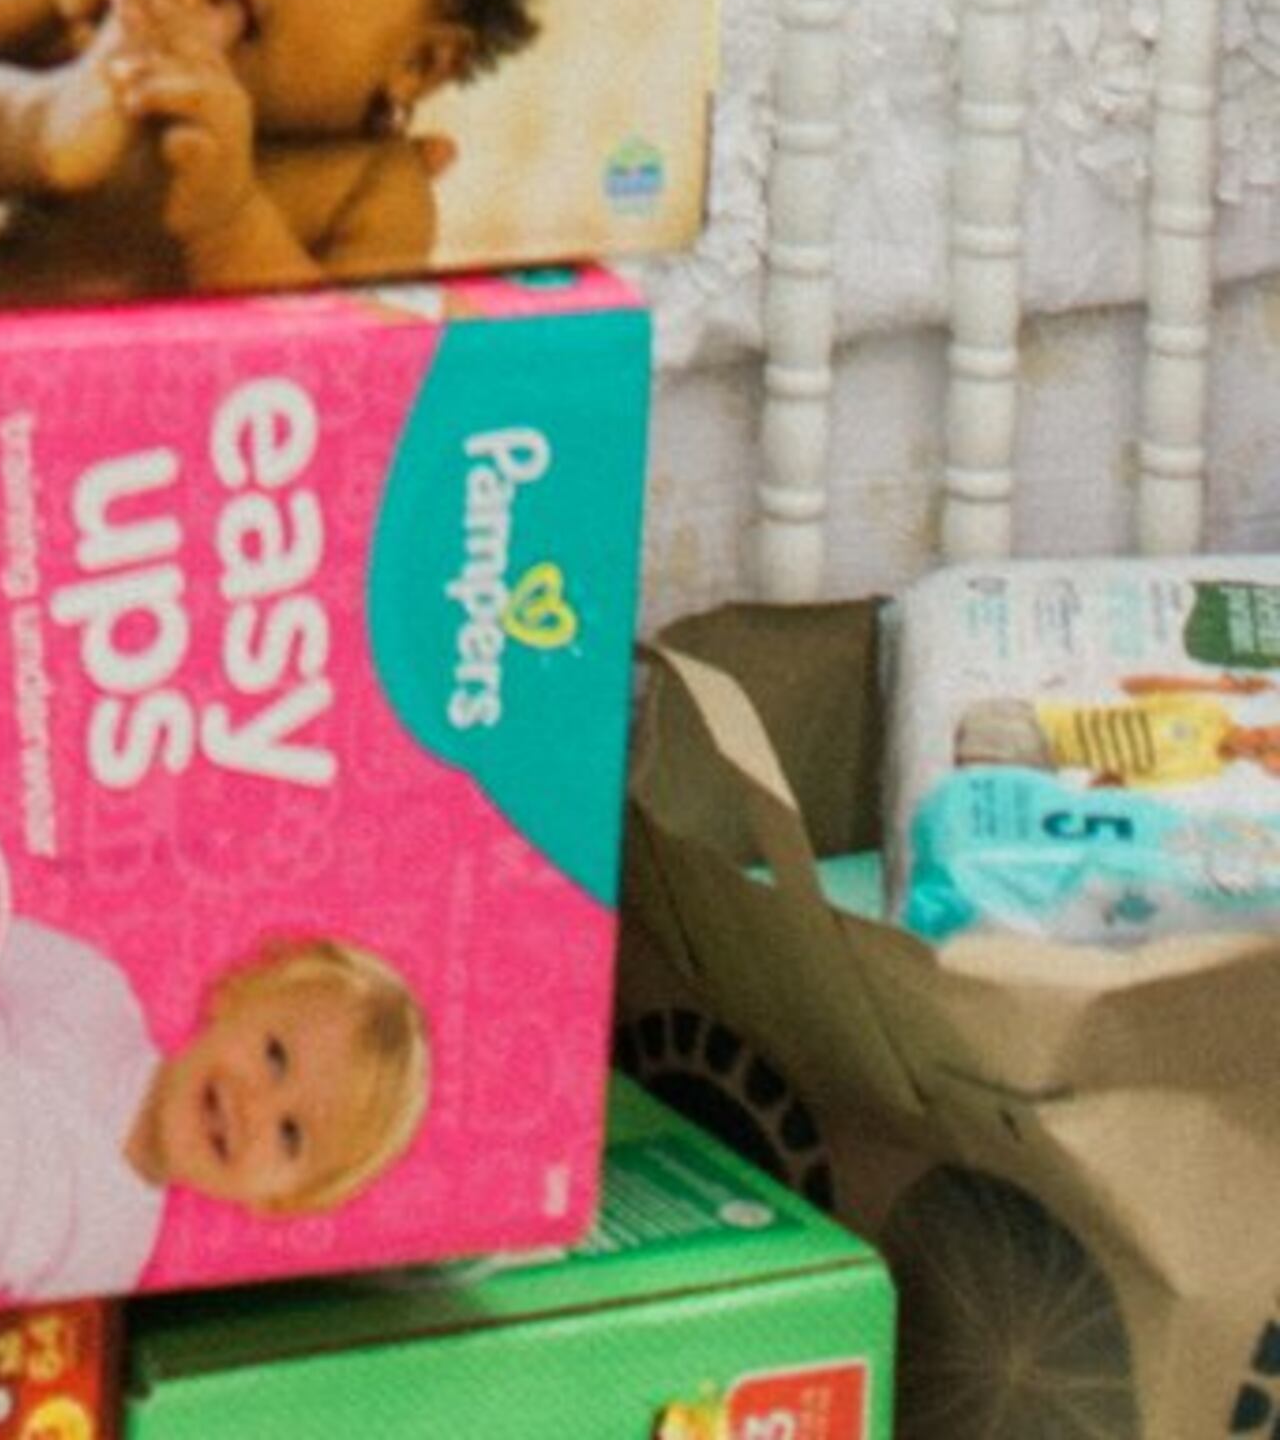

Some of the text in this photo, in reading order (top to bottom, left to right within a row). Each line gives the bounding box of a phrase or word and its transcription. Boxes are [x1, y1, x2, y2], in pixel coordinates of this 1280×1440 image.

[48, 446, 195, 789] ups
[201, 377, 337, 785] easy
[443, 426, 551, 729] Pampers
[1042, 811, 1133, 842] 5
